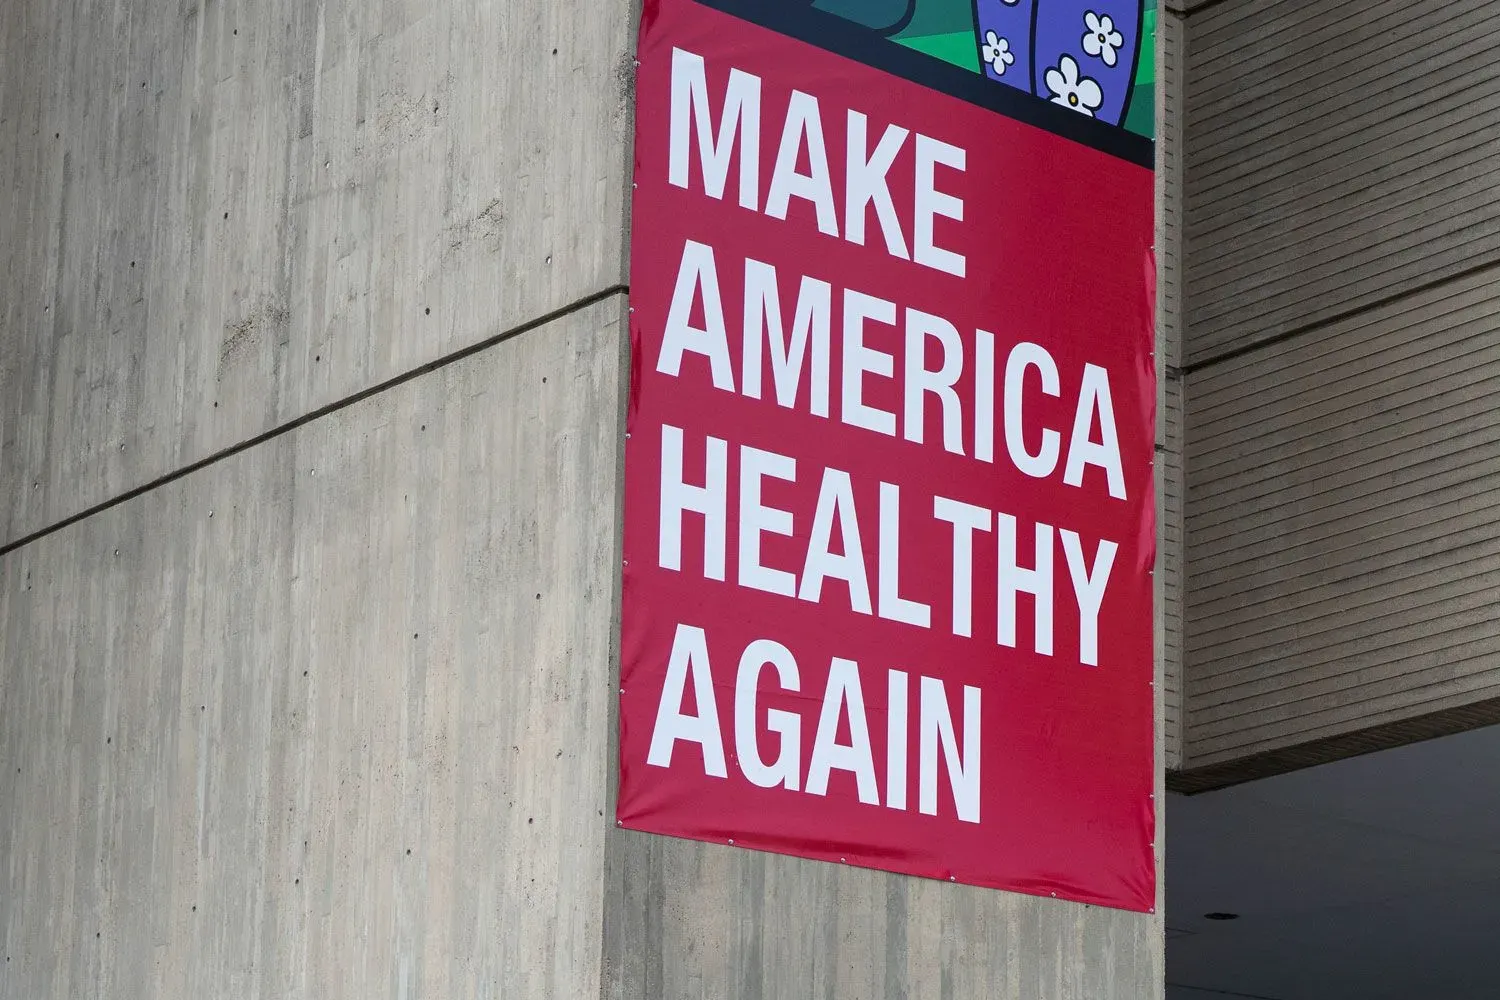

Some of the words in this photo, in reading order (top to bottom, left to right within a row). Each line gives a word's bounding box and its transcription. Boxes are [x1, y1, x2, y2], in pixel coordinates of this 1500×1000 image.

[669, 47, 965, 277] MAKE
[656, 240, 1126, 500] AMERICA
[659, 424, 1118, 666] HEALTHY
[647, 624, 982, 823] AGAIN
